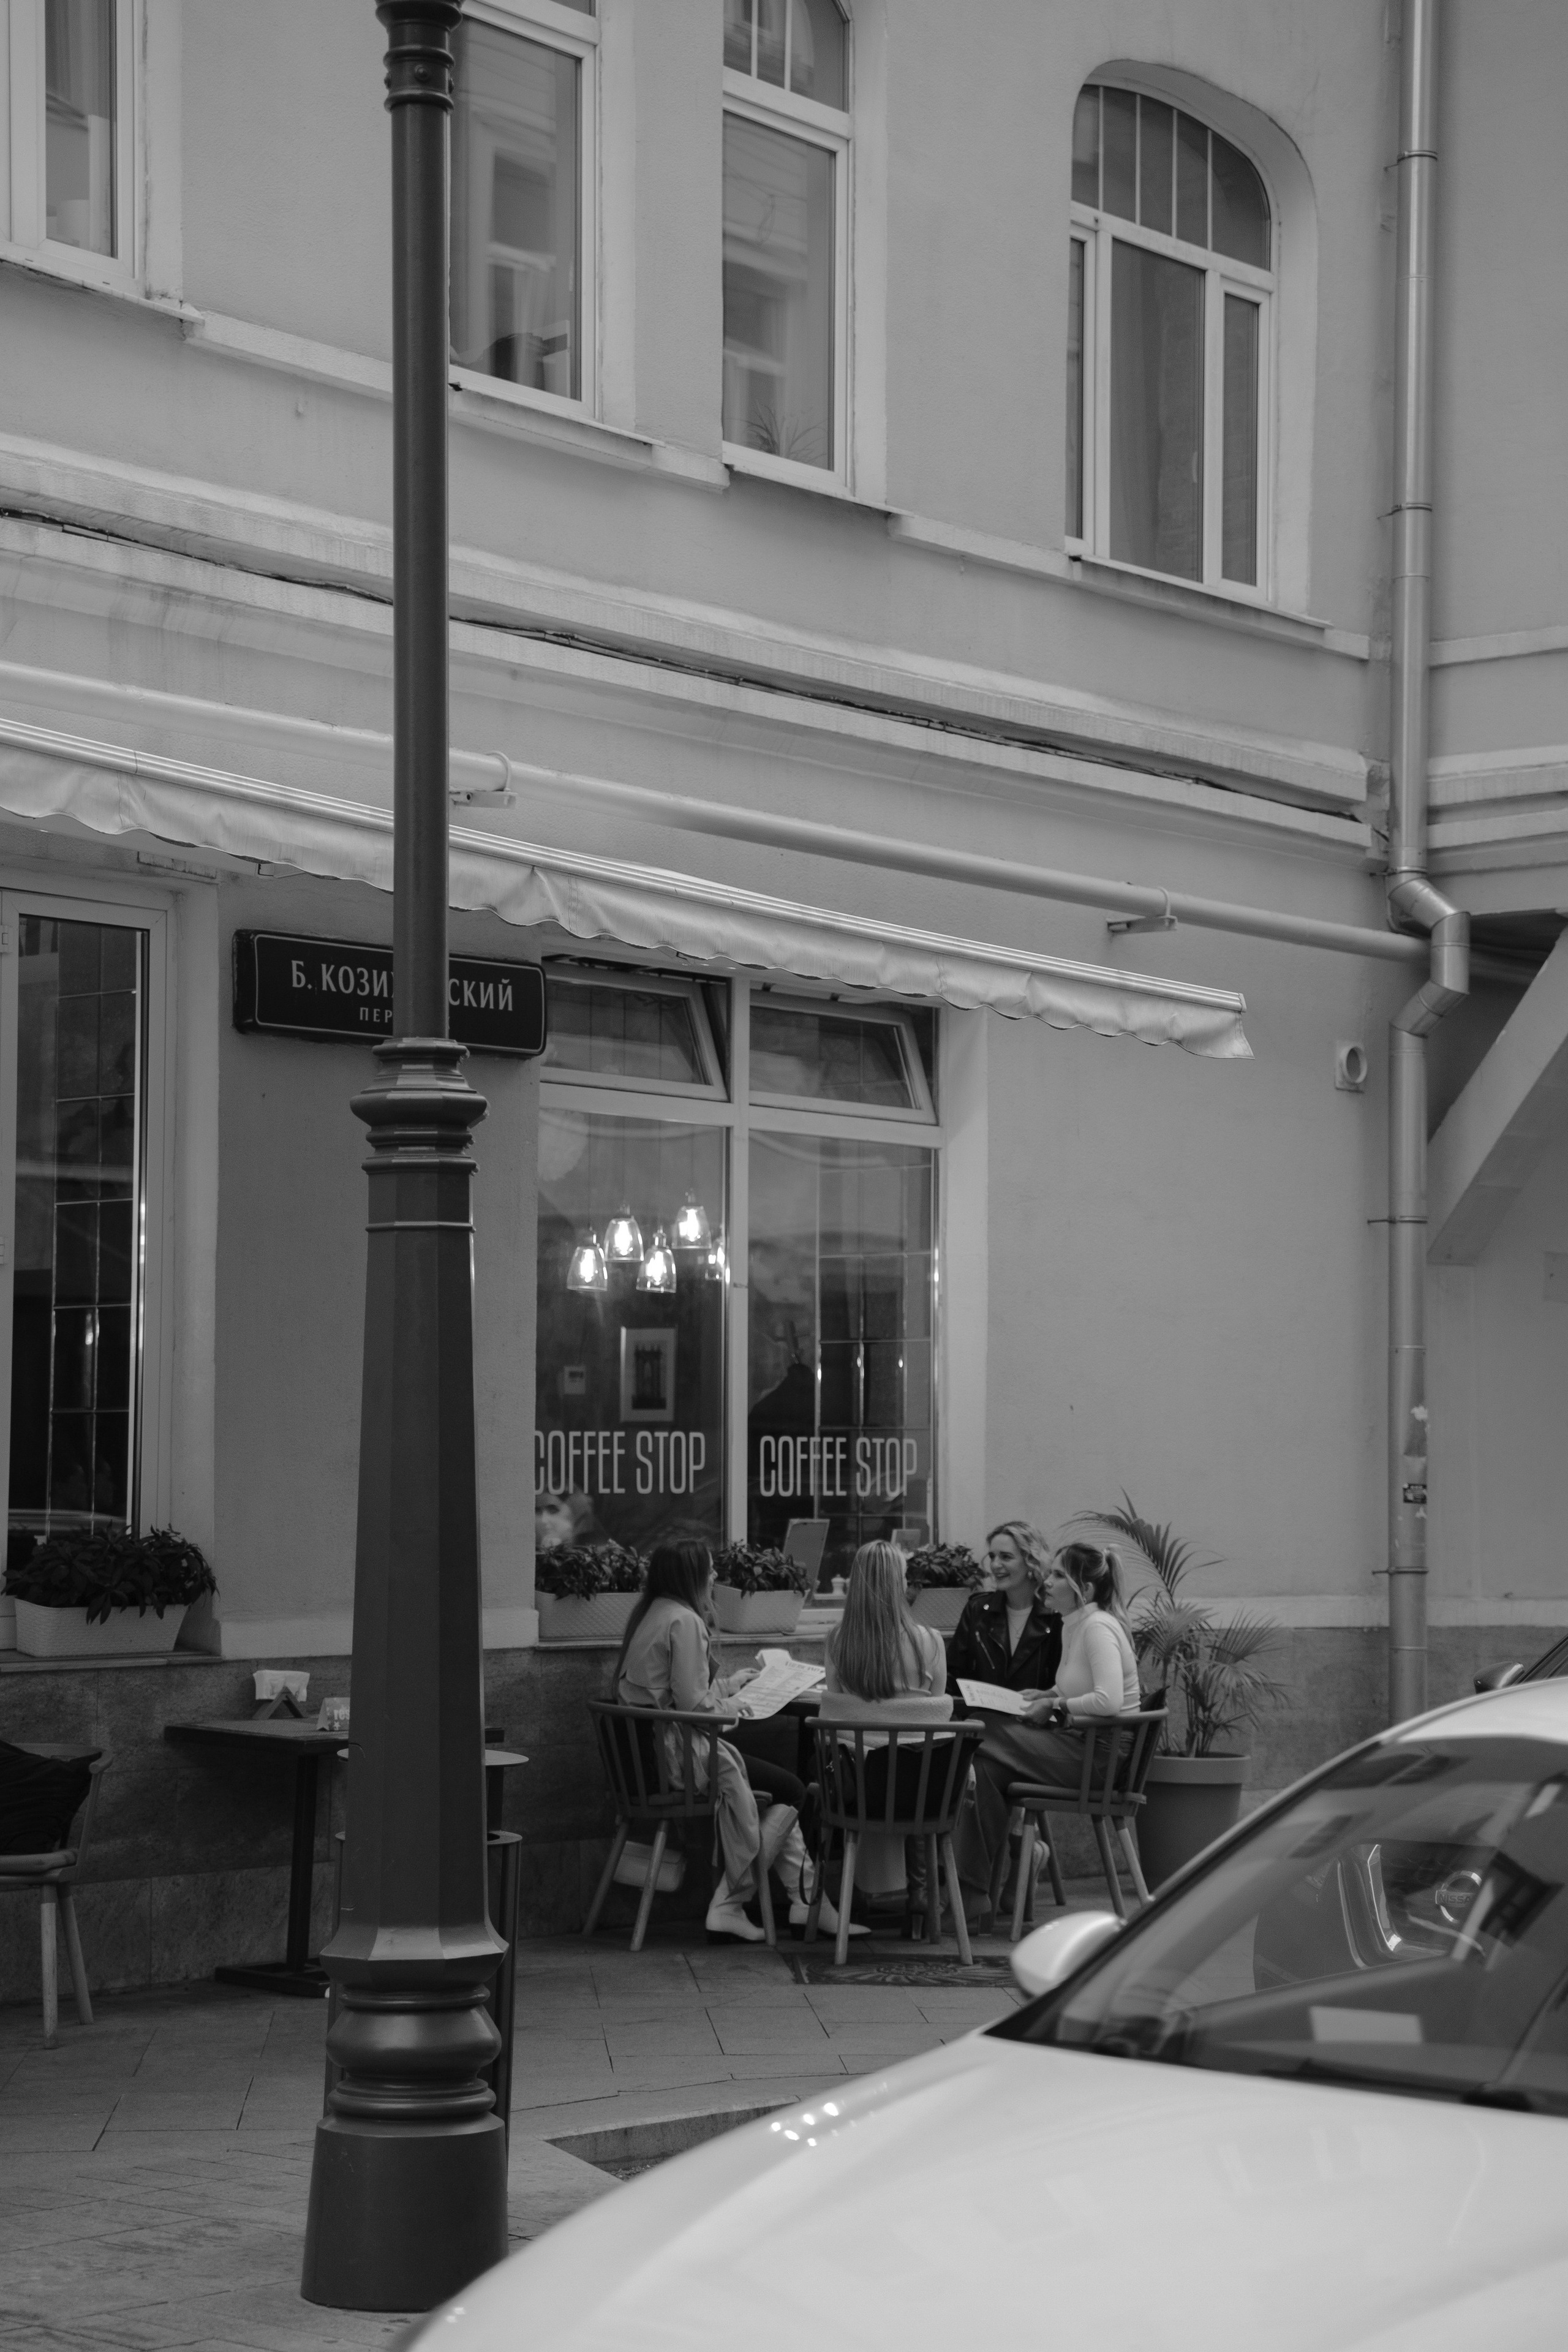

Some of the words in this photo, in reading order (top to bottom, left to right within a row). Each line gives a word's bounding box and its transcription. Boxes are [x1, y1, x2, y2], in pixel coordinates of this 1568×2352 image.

[291, 960, 312, 990] Б.
[321, 963, 513, 1011] КОЗИСКИЙ
[636, 1431, 706, 1494] STOP
[760, 1436, 847, 1498] COFFEE
[856, 1438, 917, 1497] STOP
[1439, 1893, 1473, 1904] NISSA
